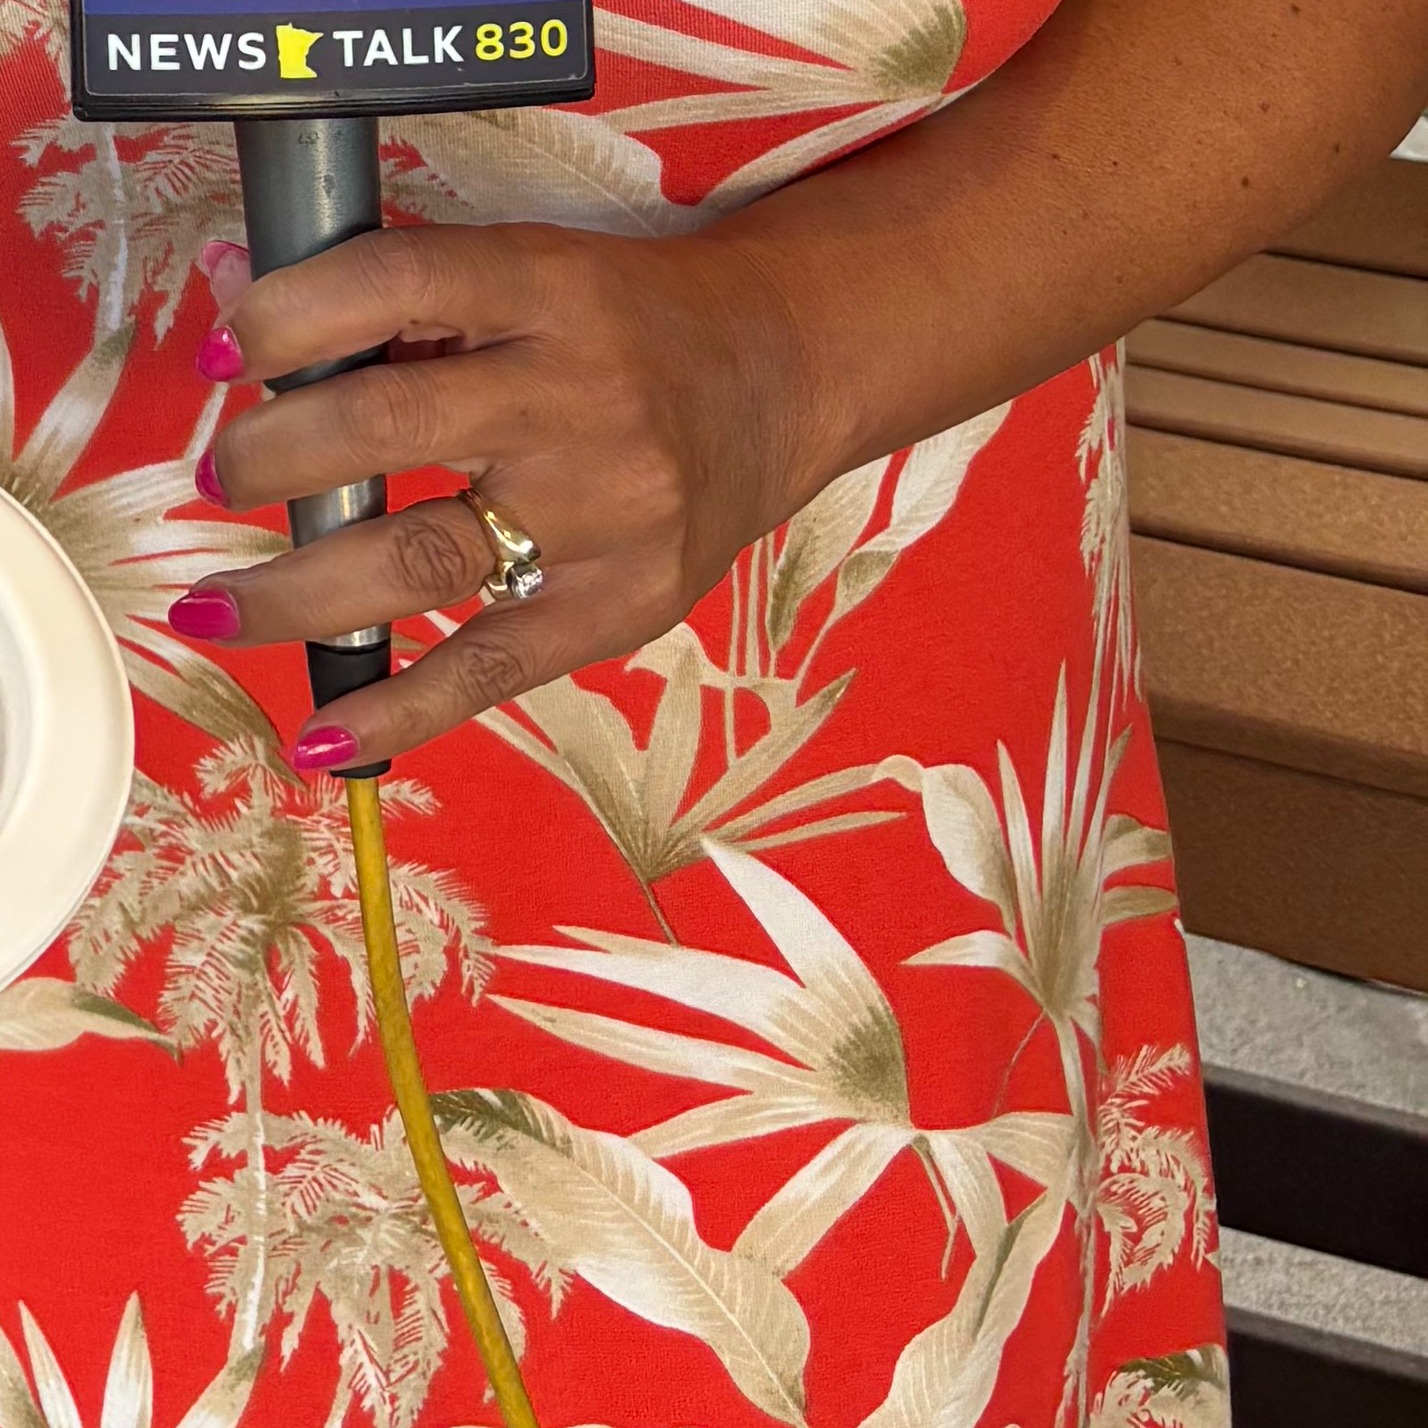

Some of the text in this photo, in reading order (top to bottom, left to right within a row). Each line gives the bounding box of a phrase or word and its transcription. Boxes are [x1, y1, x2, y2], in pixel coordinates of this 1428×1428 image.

[107, 19, 569, 71] NEWS TALK 830
